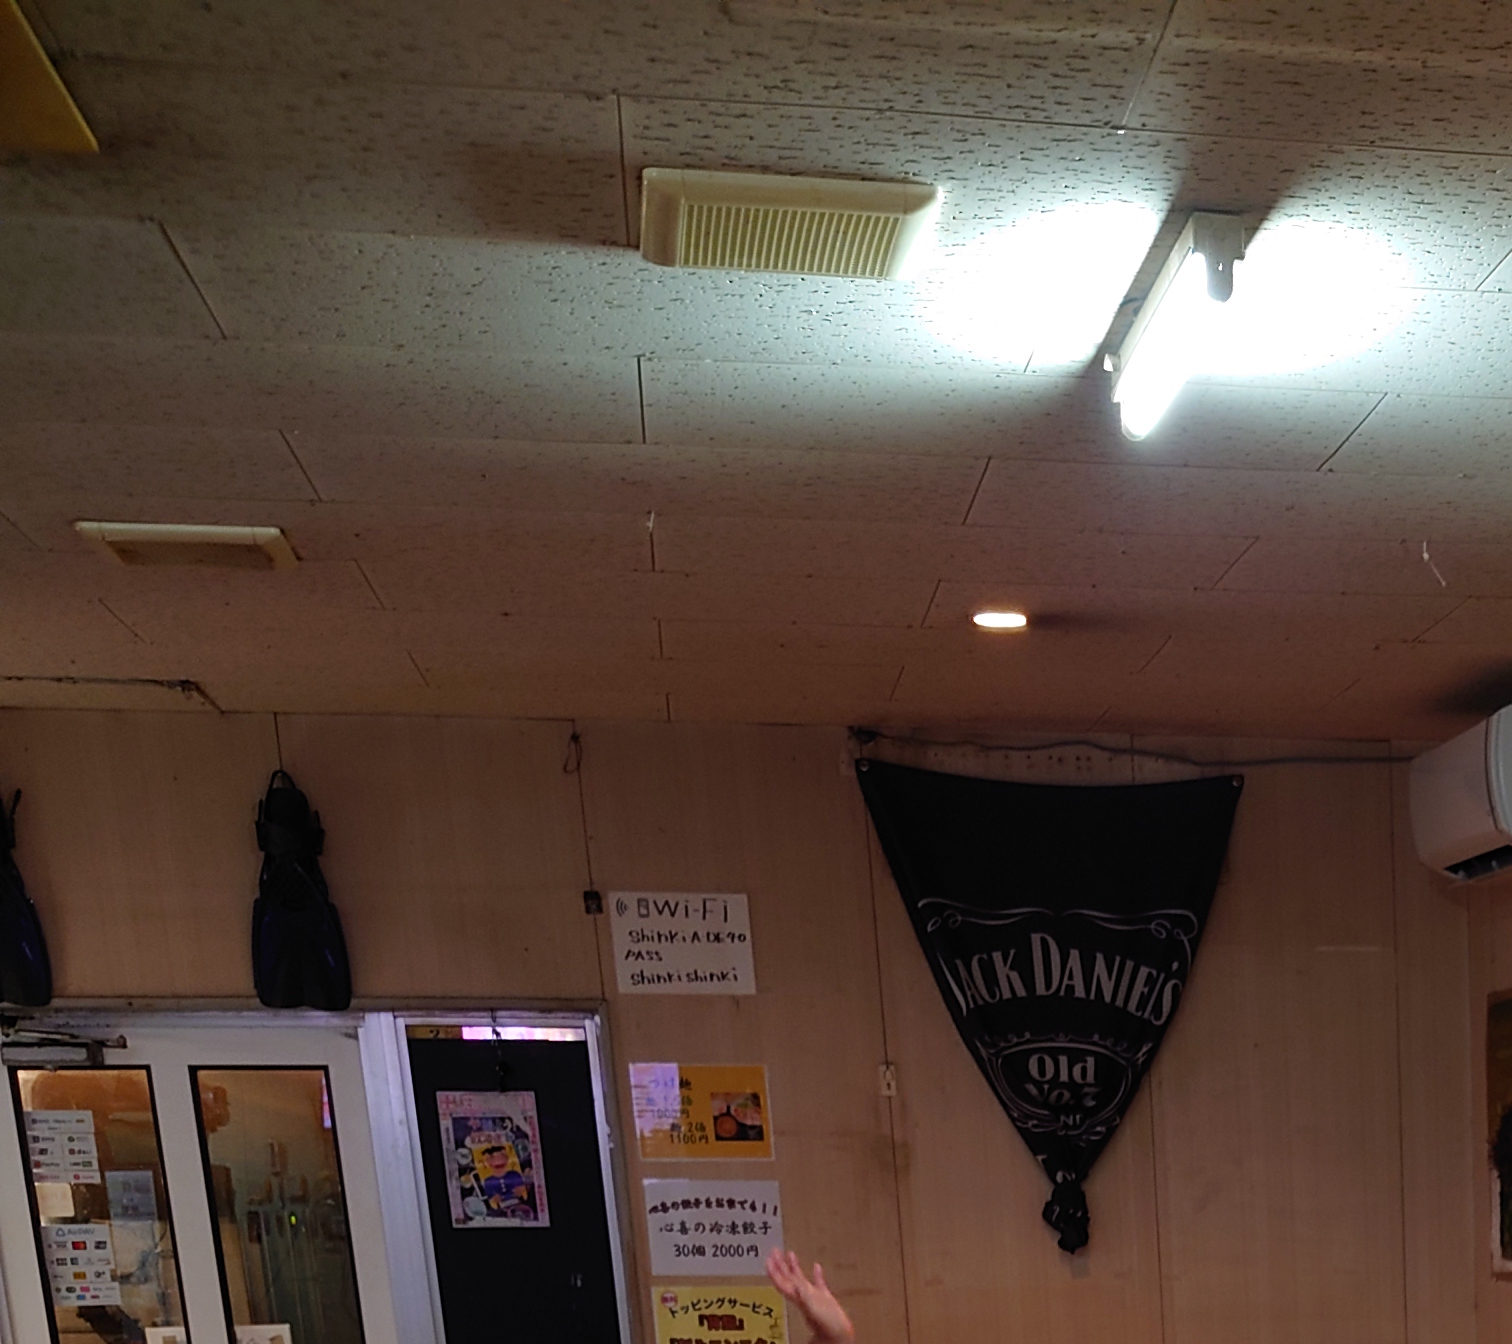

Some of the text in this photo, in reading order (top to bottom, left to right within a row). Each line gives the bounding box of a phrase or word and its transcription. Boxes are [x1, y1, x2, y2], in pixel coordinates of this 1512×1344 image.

[653, 899, 732, 924] Wi-Fi
[624, 949, 664, 962] PASS
[1027, 1053, 1097, 1085] Old
[711, 1243, 760, 1258] 2000円
[668, 1296, 775, 1319] トッピングサービス
